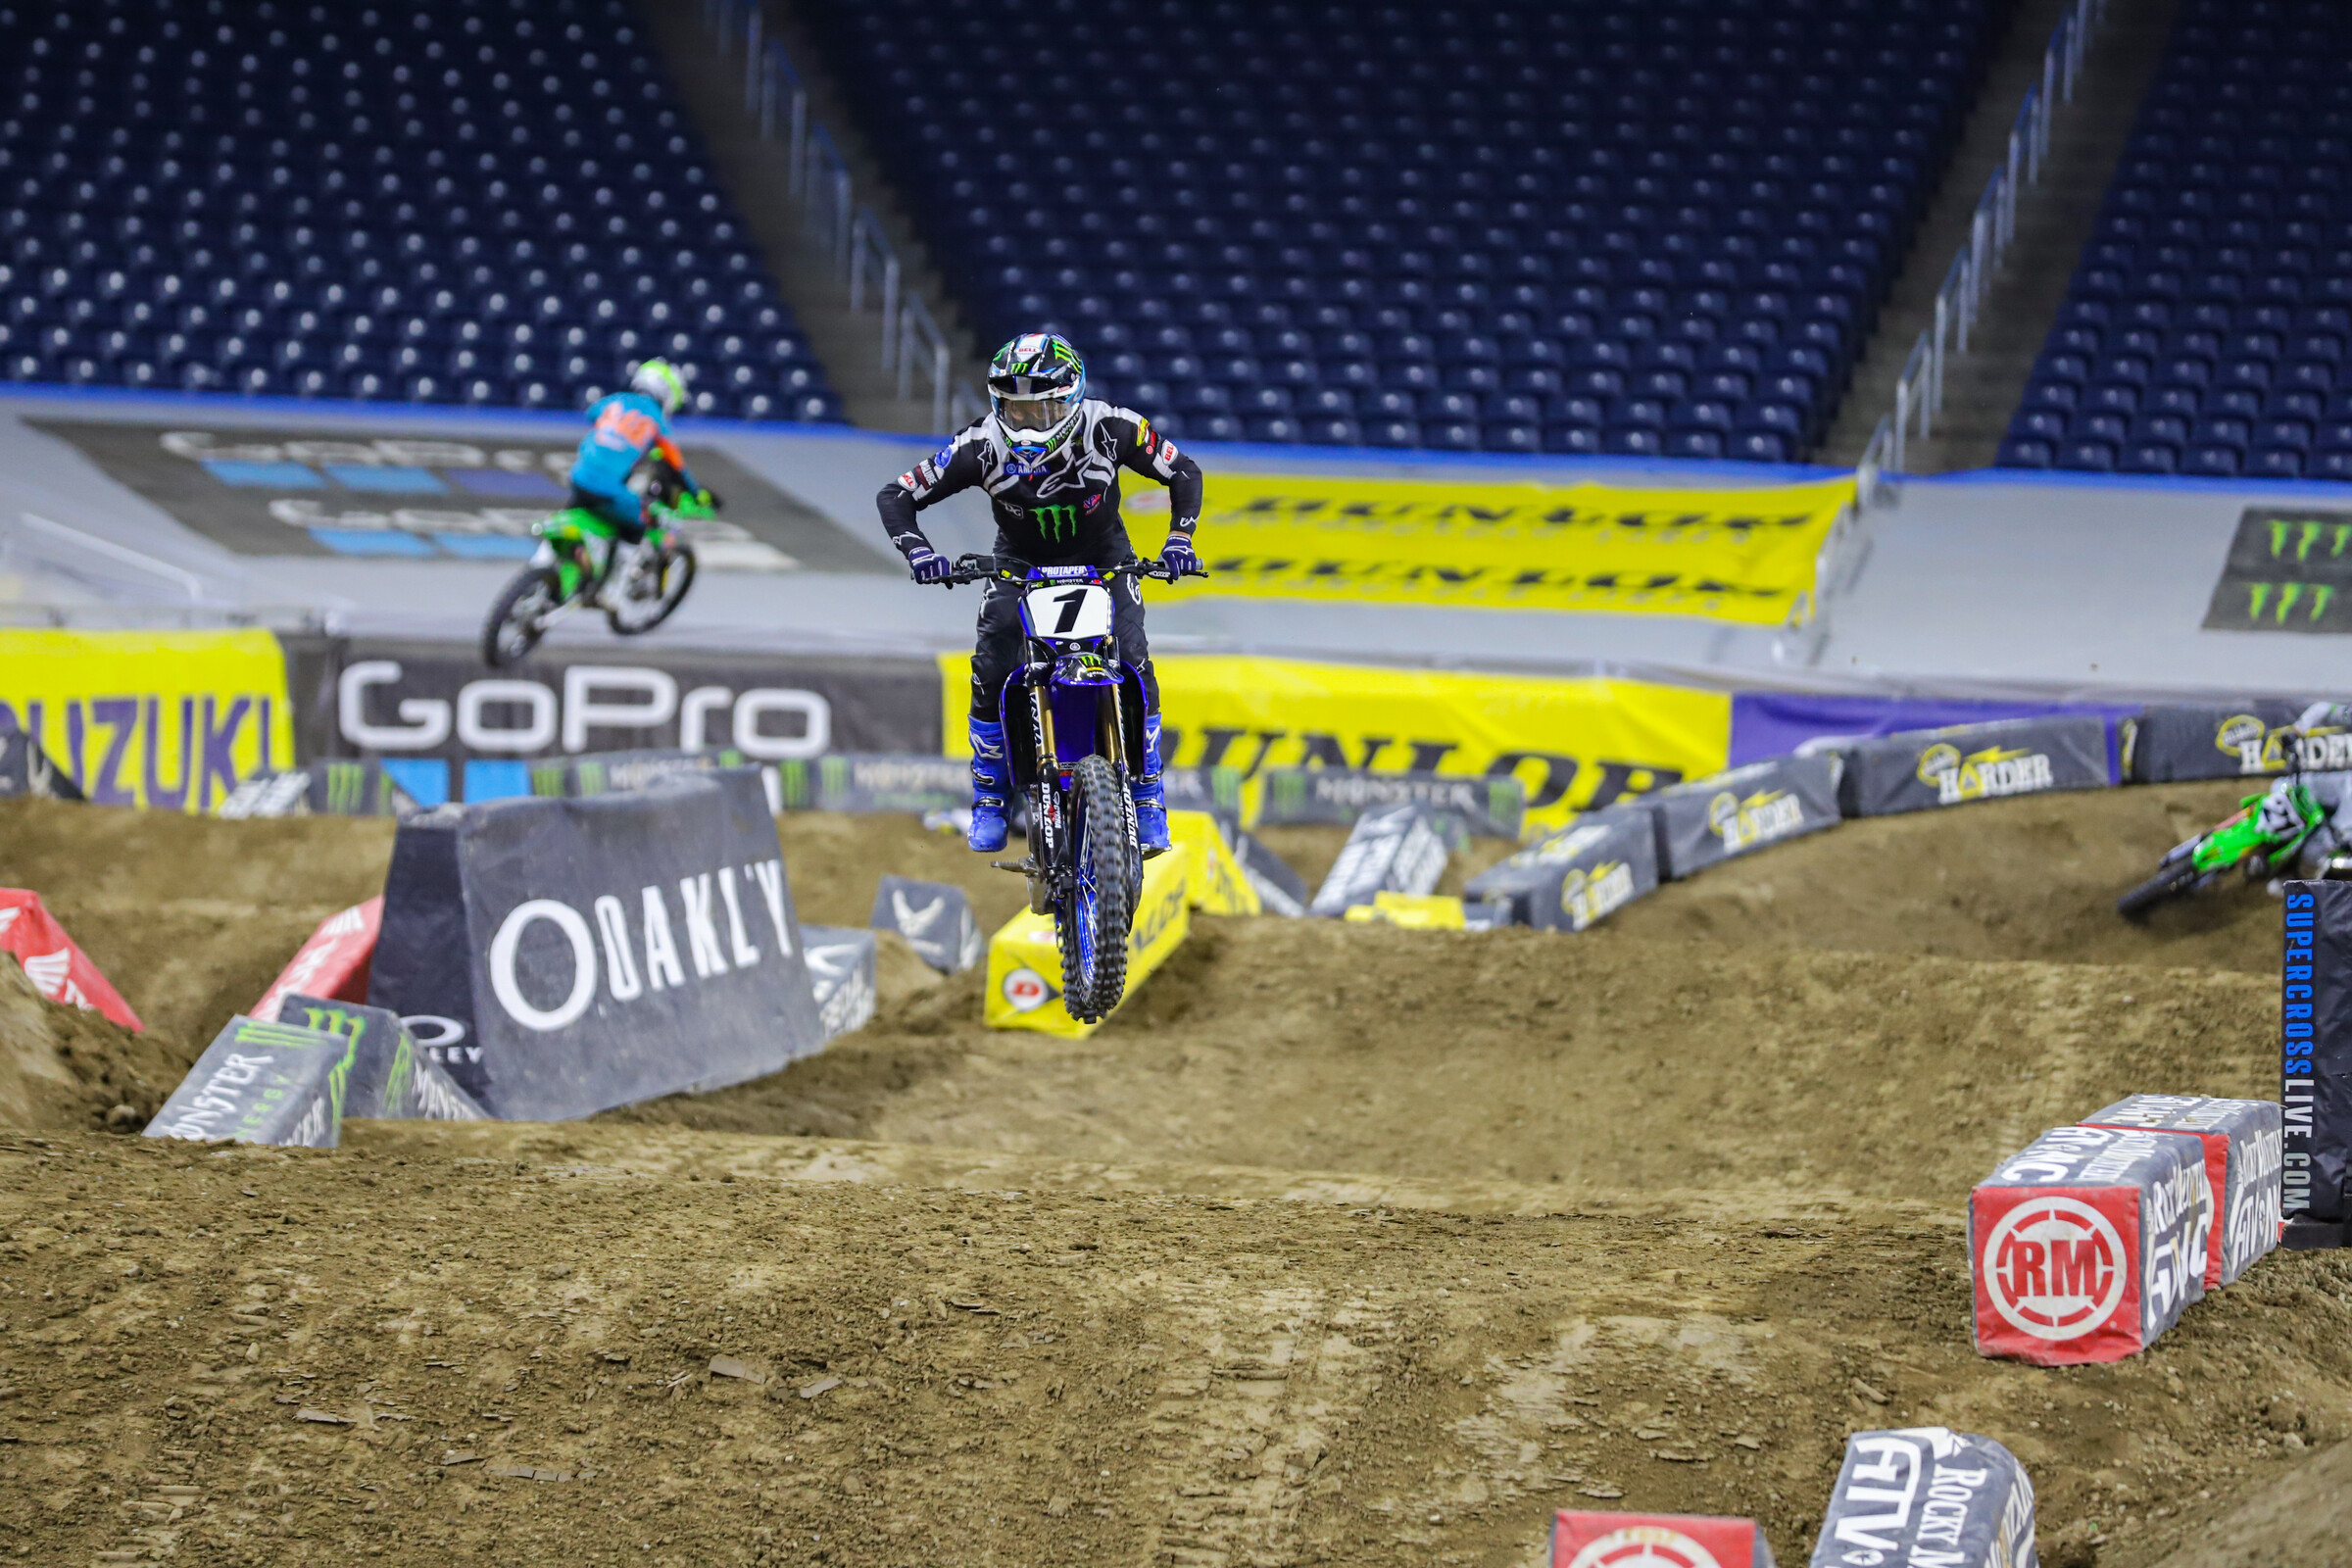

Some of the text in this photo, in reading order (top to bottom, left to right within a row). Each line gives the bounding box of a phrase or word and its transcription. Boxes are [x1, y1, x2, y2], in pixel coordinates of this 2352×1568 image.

[1053, 588, 1089, 634] 1
[337, 660, 832, 759] GoPro
[0, 697, 272, 808] UZUKI
[1041, 781, 1054, 849] DUNLOP
[2012, 1239, 2098, 1298] RM
[1916, 1463, 1987, 1546] ROCKY
